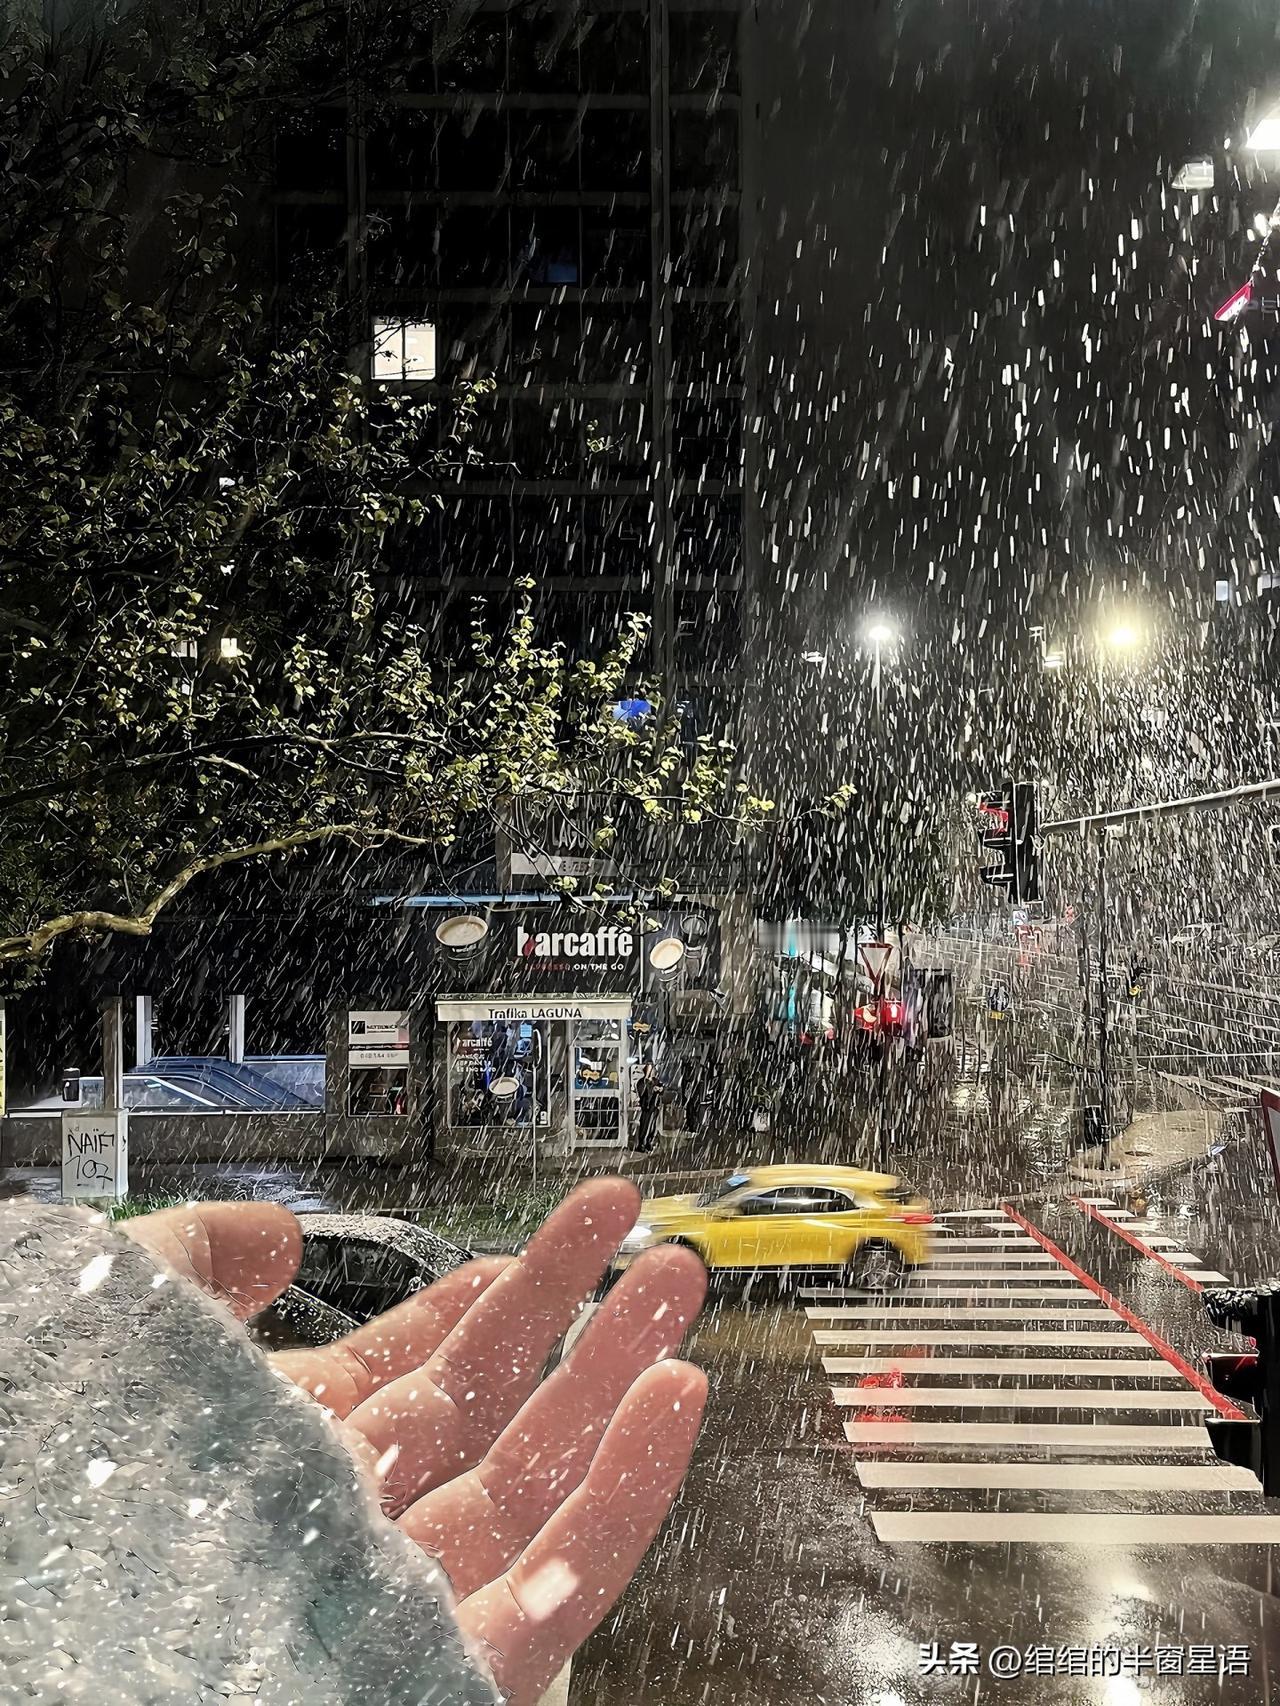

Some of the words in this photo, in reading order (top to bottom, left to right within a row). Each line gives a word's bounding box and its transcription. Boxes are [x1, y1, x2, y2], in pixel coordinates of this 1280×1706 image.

[573, 963, 588, 971] ON
[591, 963, 608, 971] THE
[610, 963, 625, 971] GO
[488, 1008, 528, 1019] Trafika
[531, 1008, 582, 1019] LAGUNA
